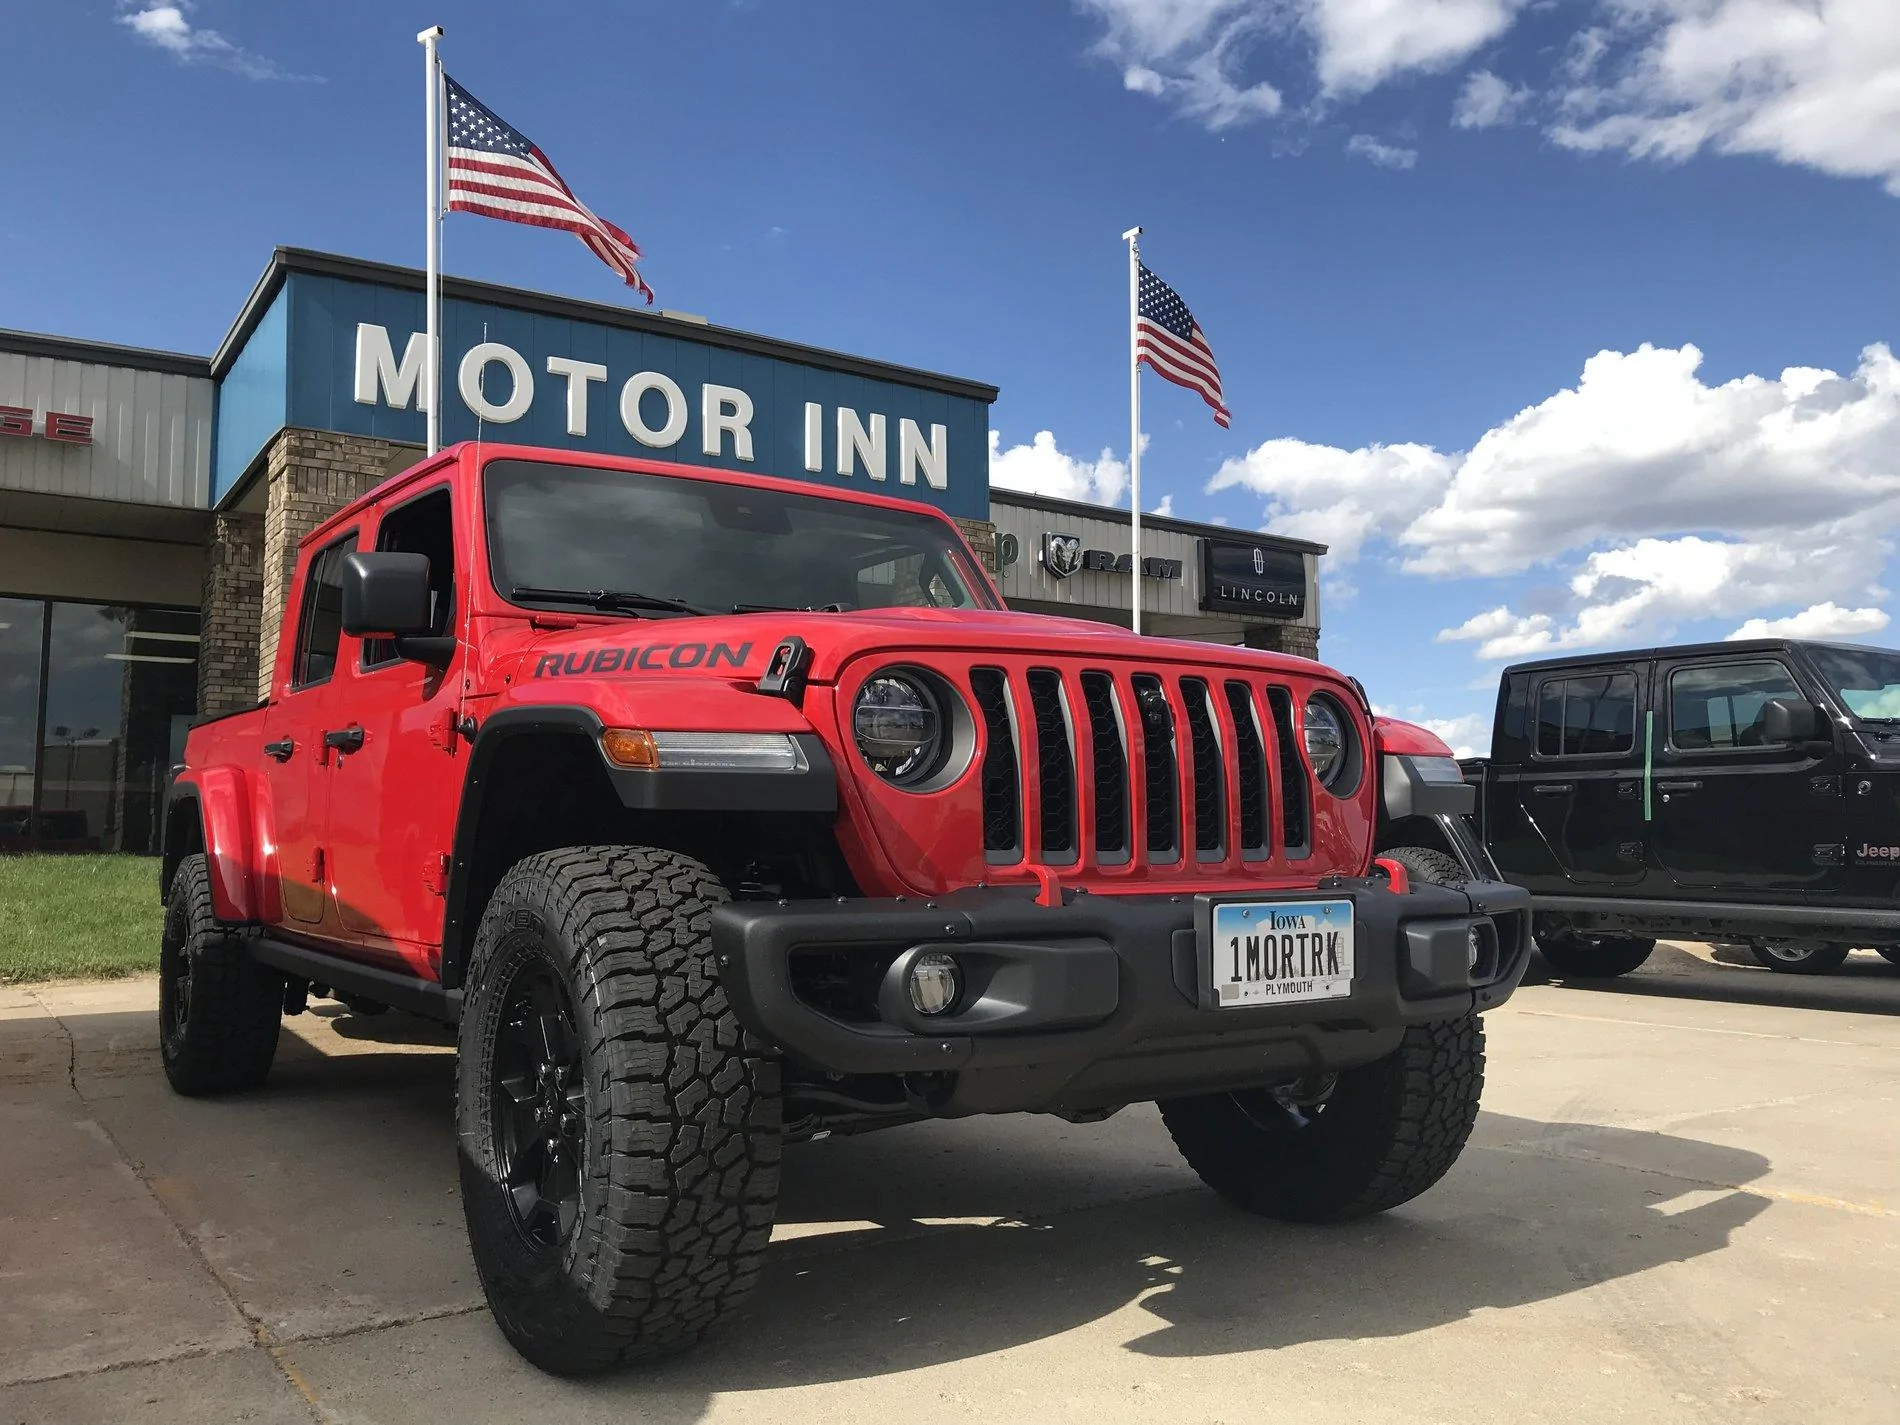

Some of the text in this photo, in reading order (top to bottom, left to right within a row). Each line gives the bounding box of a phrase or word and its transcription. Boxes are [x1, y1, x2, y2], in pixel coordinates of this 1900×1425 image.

[354, 322, 947, 490] MOTOR INN
[1082, 549, 1182, 579] RAM
[1220, 585, 1298, 606] LINCOLN
[533, 642, 753, 678] RUBICON
[1856, 843, 1900, 860] Jeep
[1230, 931, 1340, 982] 1MORTRK
[1265, 981, 1313, 996] PLYMOUTH
